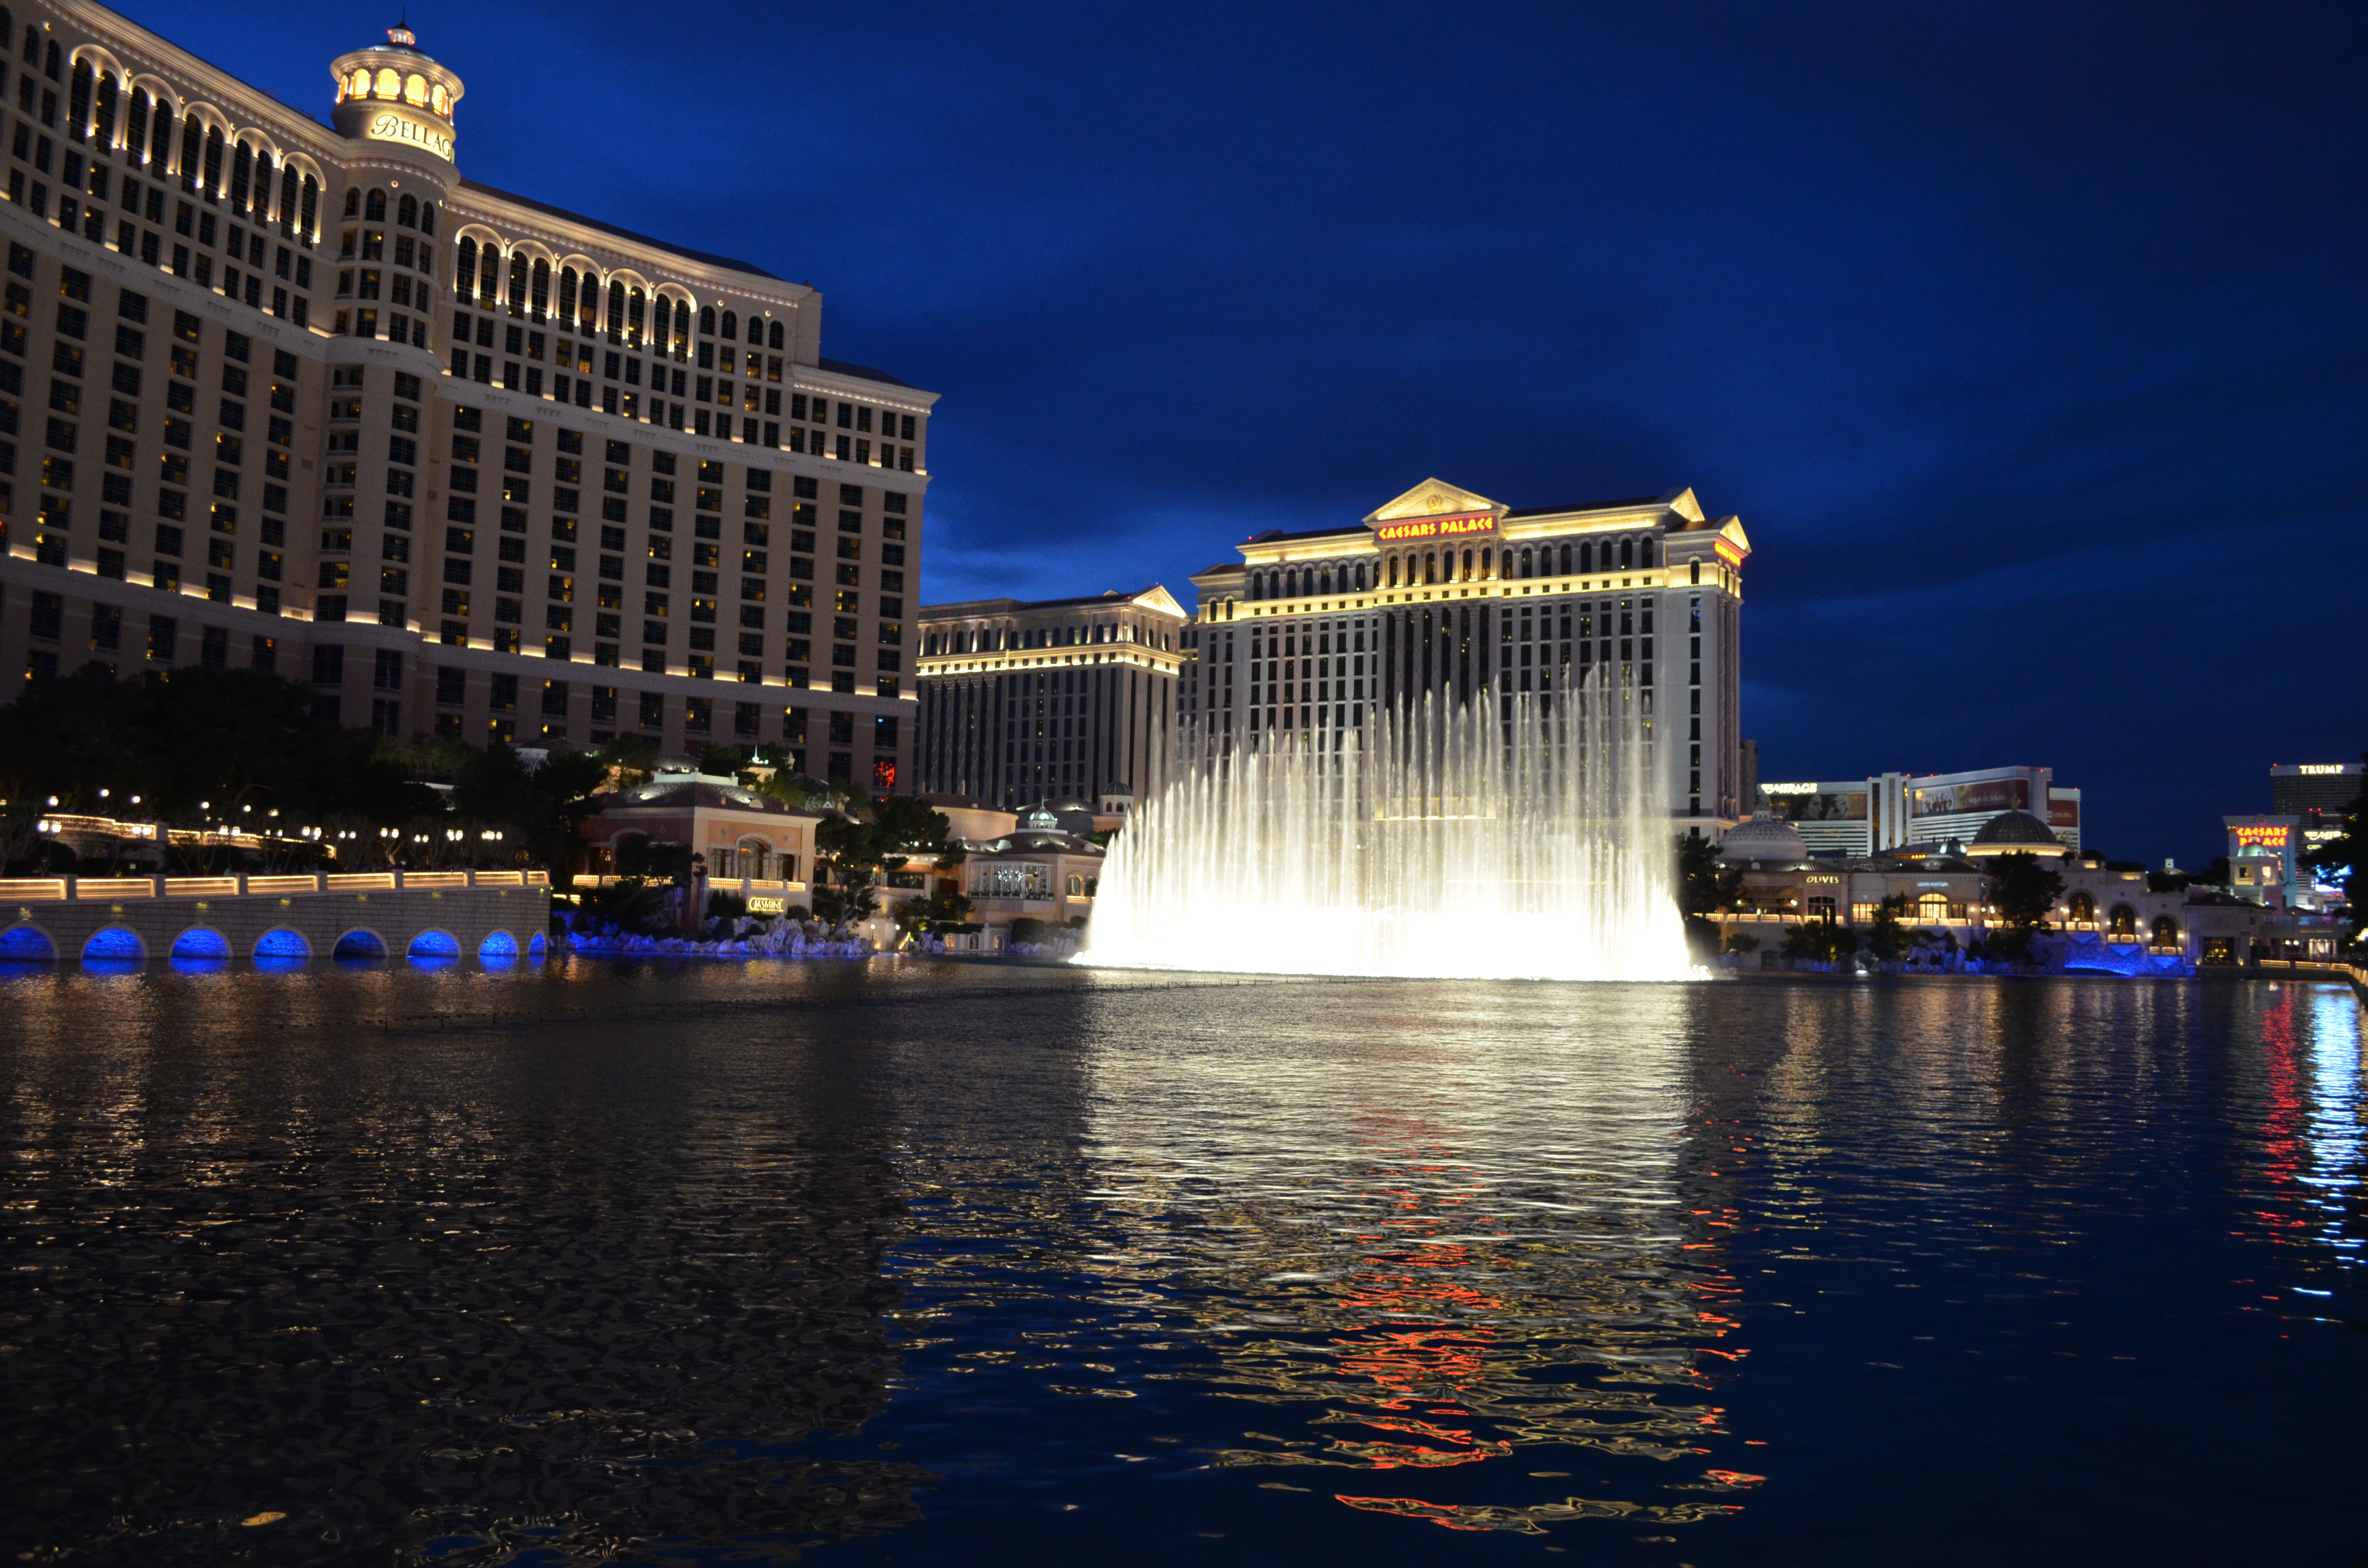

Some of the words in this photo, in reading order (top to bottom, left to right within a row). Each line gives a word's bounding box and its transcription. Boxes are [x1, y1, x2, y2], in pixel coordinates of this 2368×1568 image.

[371, 114, 451, 157] BELLAG
[1379, 523, 1436, 540] CAESARS
[1440, 516, 1493, 535] PALACE
[2299, 765, 2343, 774] TRUMP
[1764, 783, 1818, 794] MIRAGE
[2236, 827, 2288, 836] CAESARS
